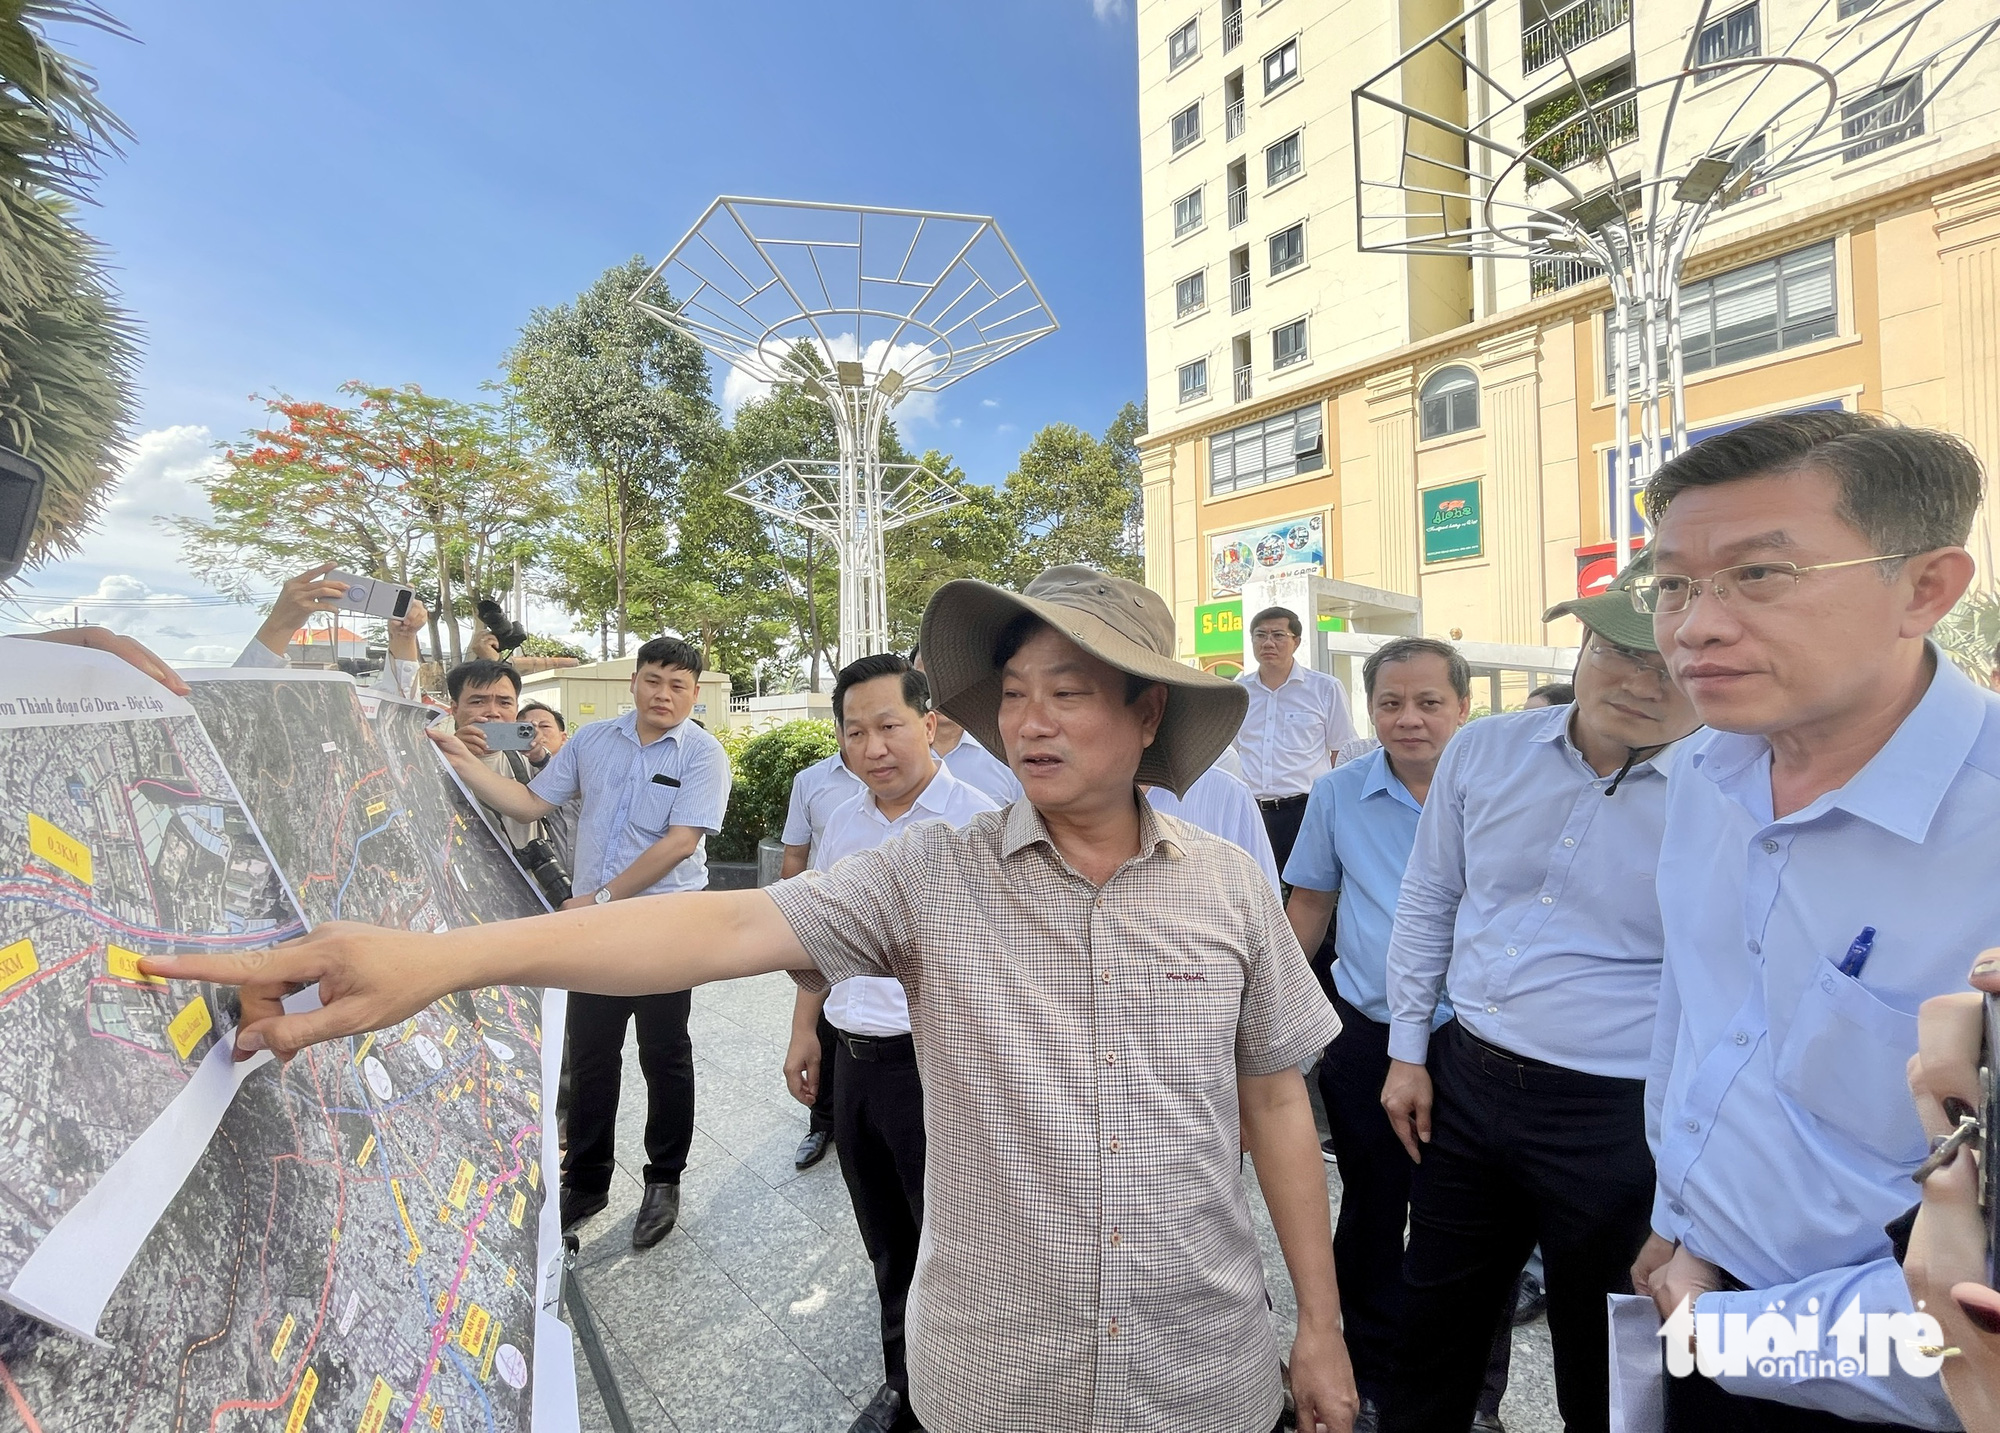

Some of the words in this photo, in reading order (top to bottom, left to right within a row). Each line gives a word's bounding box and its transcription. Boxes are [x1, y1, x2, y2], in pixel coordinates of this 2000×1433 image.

[16, 697, 55, 715] Thành
[56, 697, 79, 717] đoạn
[94, 697, 120, 712] Dưa
[126, 695, 145, 713] Độc
[143, 695, 164, 712] Lập
